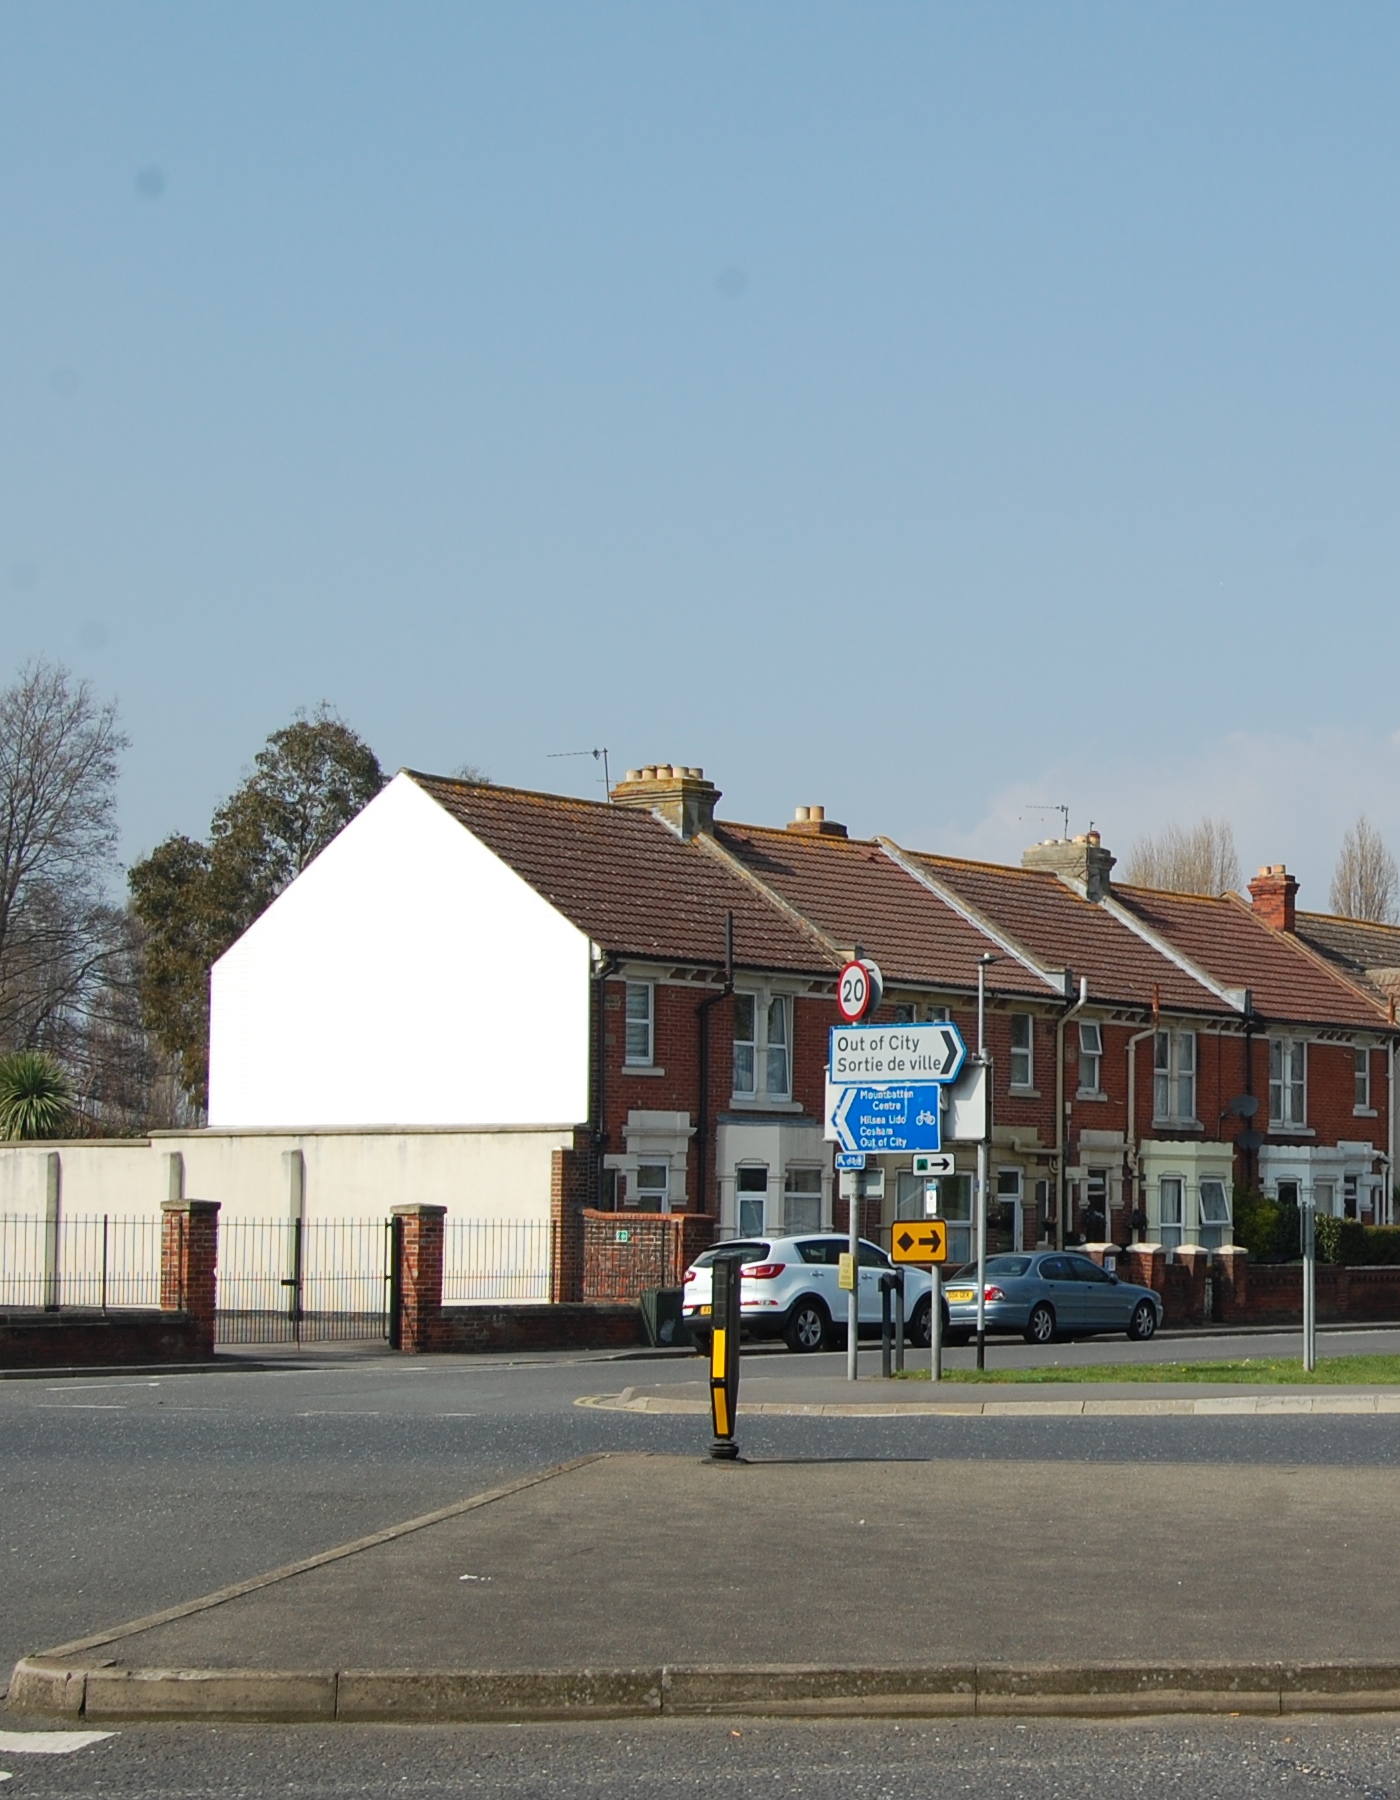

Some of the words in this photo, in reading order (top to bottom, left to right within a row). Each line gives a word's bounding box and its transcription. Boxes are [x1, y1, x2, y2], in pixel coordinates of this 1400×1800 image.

[843, 978, 864, 1002] 20
[837, 1036, 865, 1052] Out
[869, 1035, 884, 1051] of
[888, 1035, 919, 1053] City
[837, 1056, 883, 1072] Sortie
[887, 1056, 905, 1071] de
[909, 1055, 941, 1070] ville
[860, 1089, 914, 1100] Mountbatten
[872, 1101, 901, 1111] Centre
[860, 1115, 886, 1125] Hilsea
[888, 1115, 906, 1125] Lido
[860, 1126, 893, 1136] Cosham
[860, 1138, 876, 1148] Out
[878, 1137, 887, 1147] of
[889, 1136, 907, 1149] City
